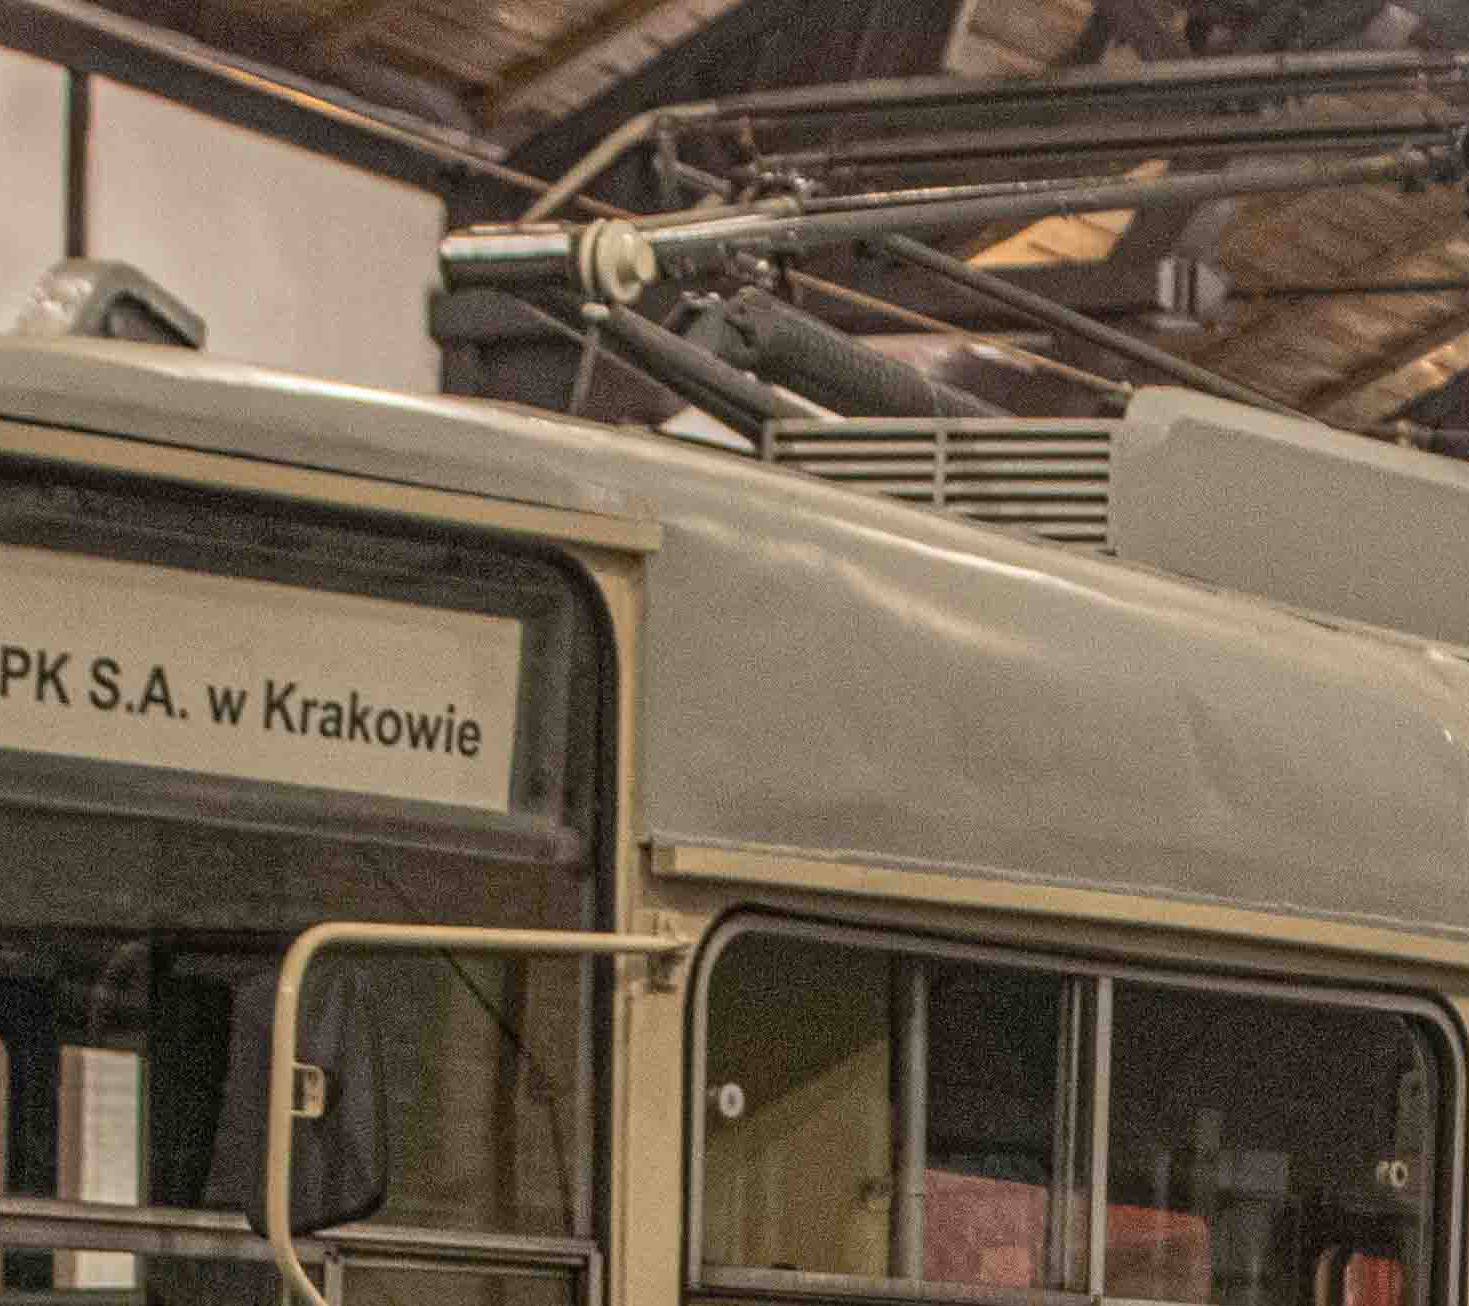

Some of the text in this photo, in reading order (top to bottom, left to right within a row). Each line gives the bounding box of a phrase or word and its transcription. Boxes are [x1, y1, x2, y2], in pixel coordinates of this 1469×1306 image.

[88, 656, 189, 720] S.A.
[206, 684, 248, 727] w
[262, 679, 483, 759] Krakowie
